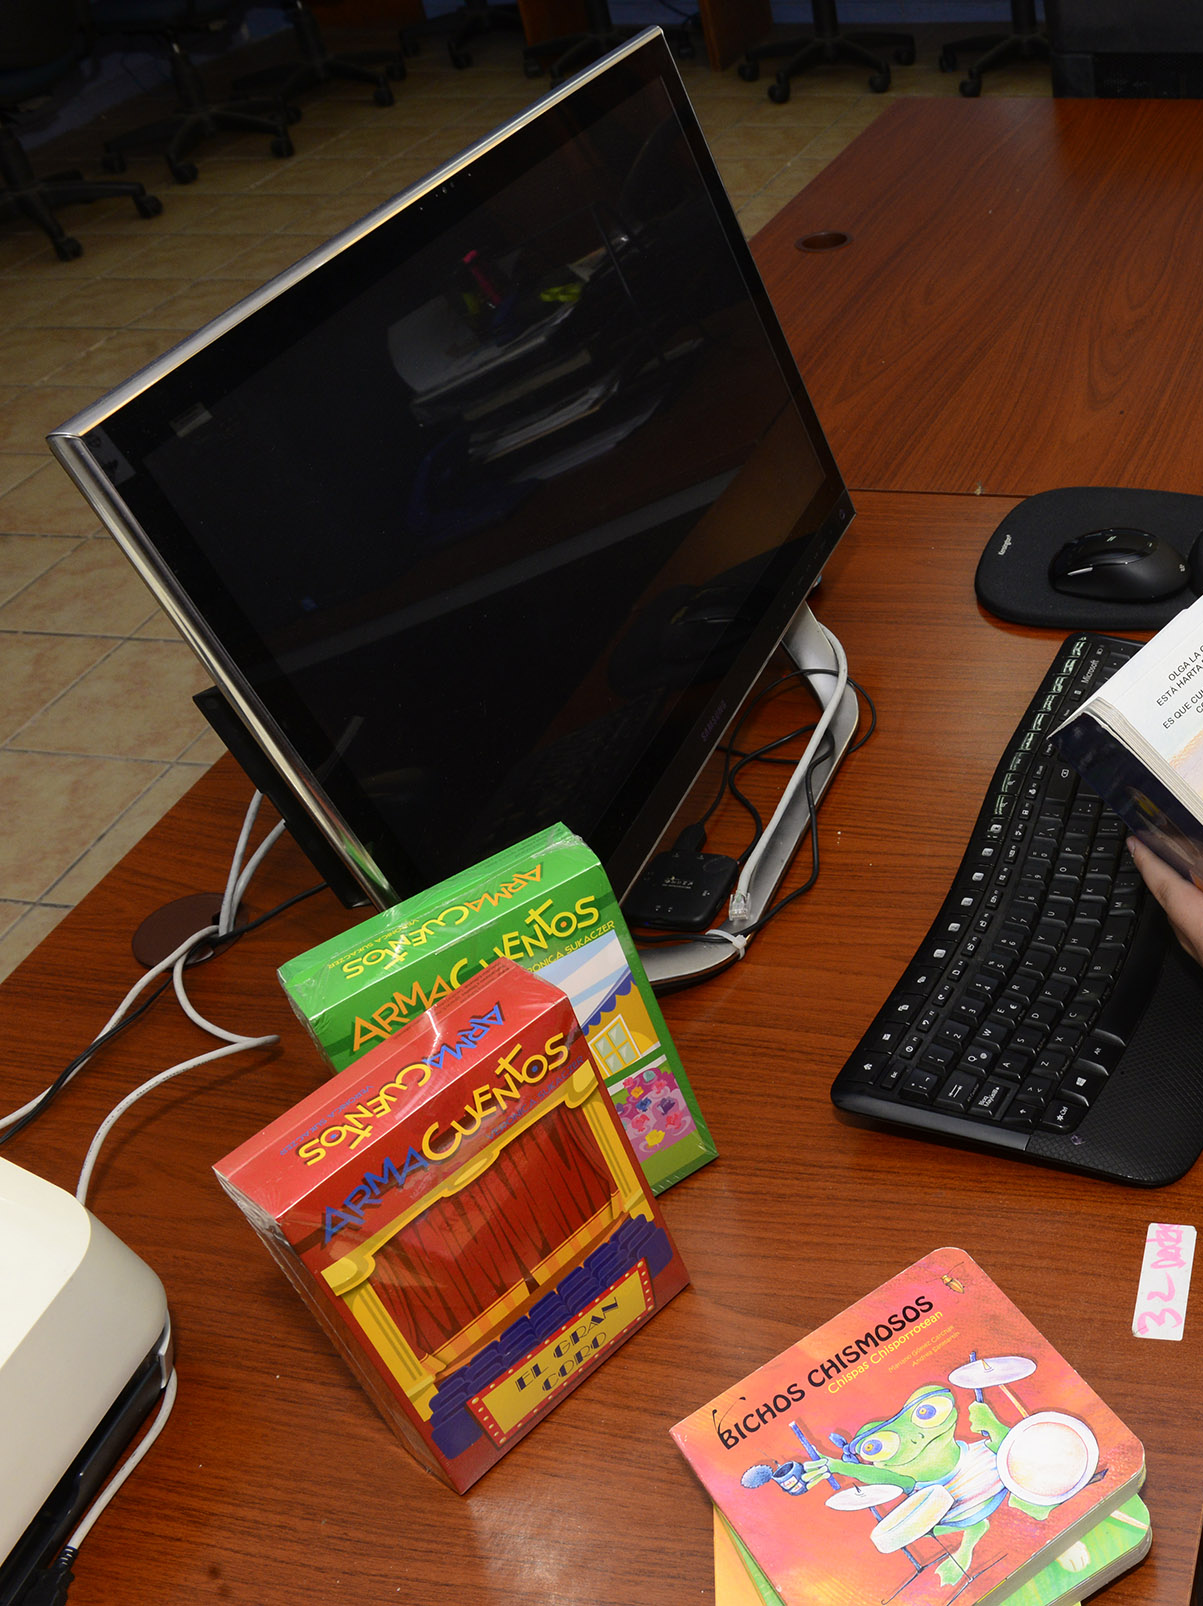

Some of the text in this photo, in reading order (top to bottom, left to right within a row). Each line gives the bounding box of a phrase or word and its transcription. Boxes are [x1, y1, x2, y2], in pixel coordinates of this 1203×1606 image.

[1080, 660, 1100, 684] Microsoft
[1168, 661, 1190, 682] OLGA
[1188, 652, 1201, 663] LA
[1177, 664, 1203, 688] HARTA
[1162, 717, 1175, 729] ES
[1174, 702, 1192, 718] QUE
[565, 920, 616, 954] SUKACZER
[515, 1297, 618, 1392] EL GRAN
[542, 1332, 606, 1391] CORO
[827, 1311, 943, 1394] Chispas Chisporrotean
[718, 1295, 934, 1450] BICHOS CHISMOSOS
